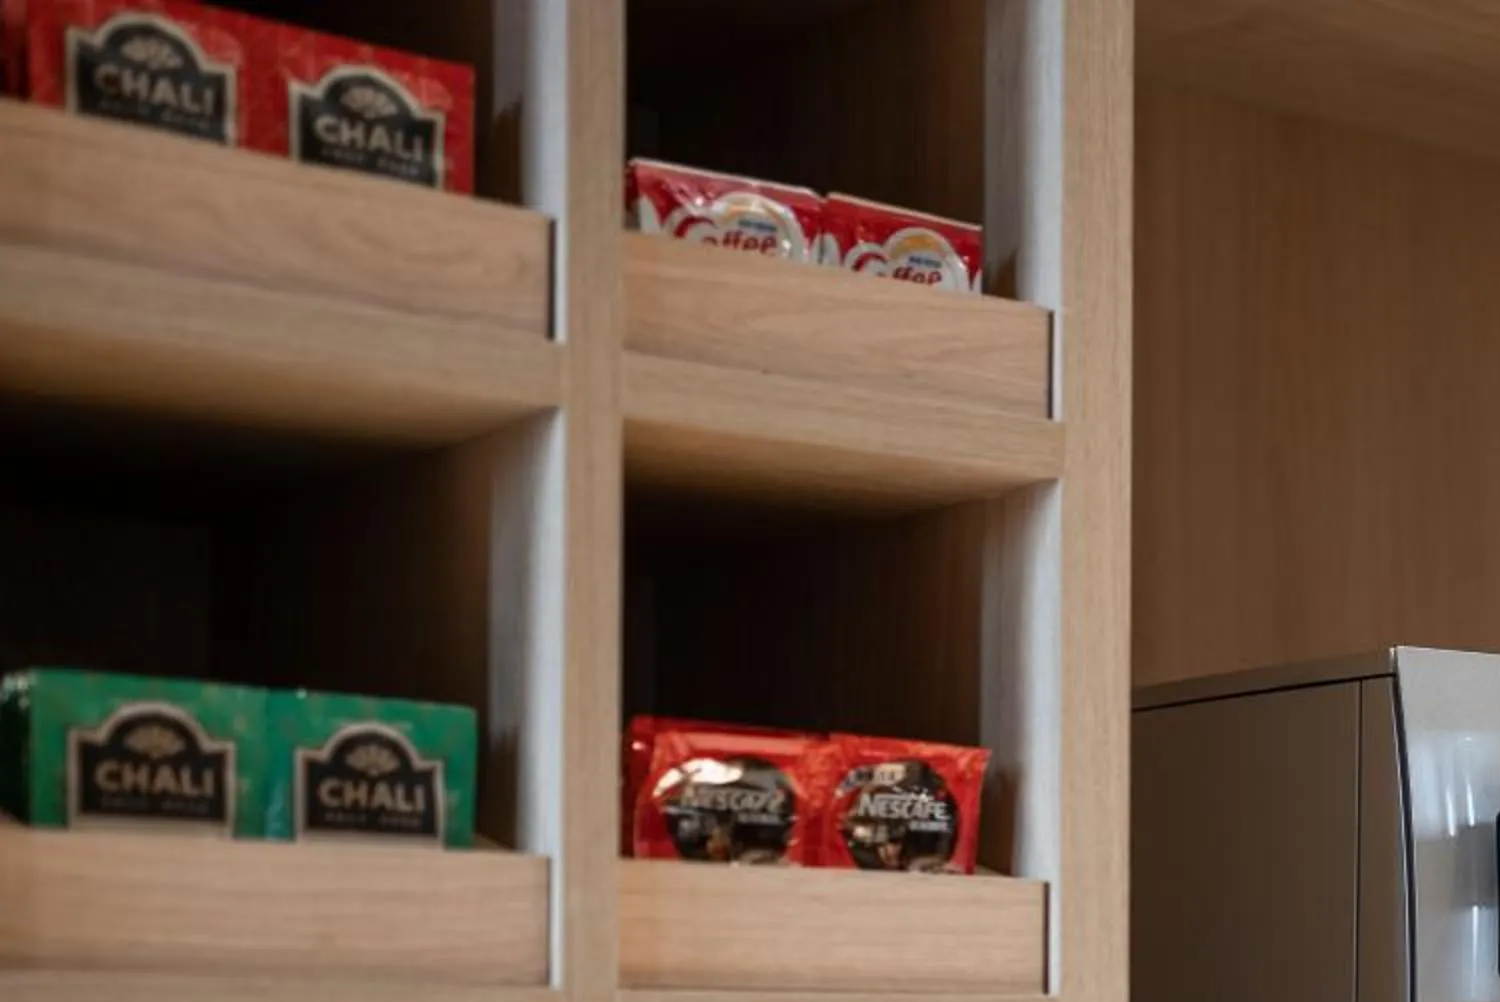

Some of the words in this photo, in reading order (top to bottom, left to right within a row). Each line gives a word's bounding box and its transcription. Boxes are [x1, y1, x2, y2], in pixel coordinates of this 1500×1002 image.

[95, 64, 214, 115] CHALI
[314, 113, 423, 161] CHALI
[95, 759, 215, 797] CHALI
[318, 778, 425, 813] CHALI
